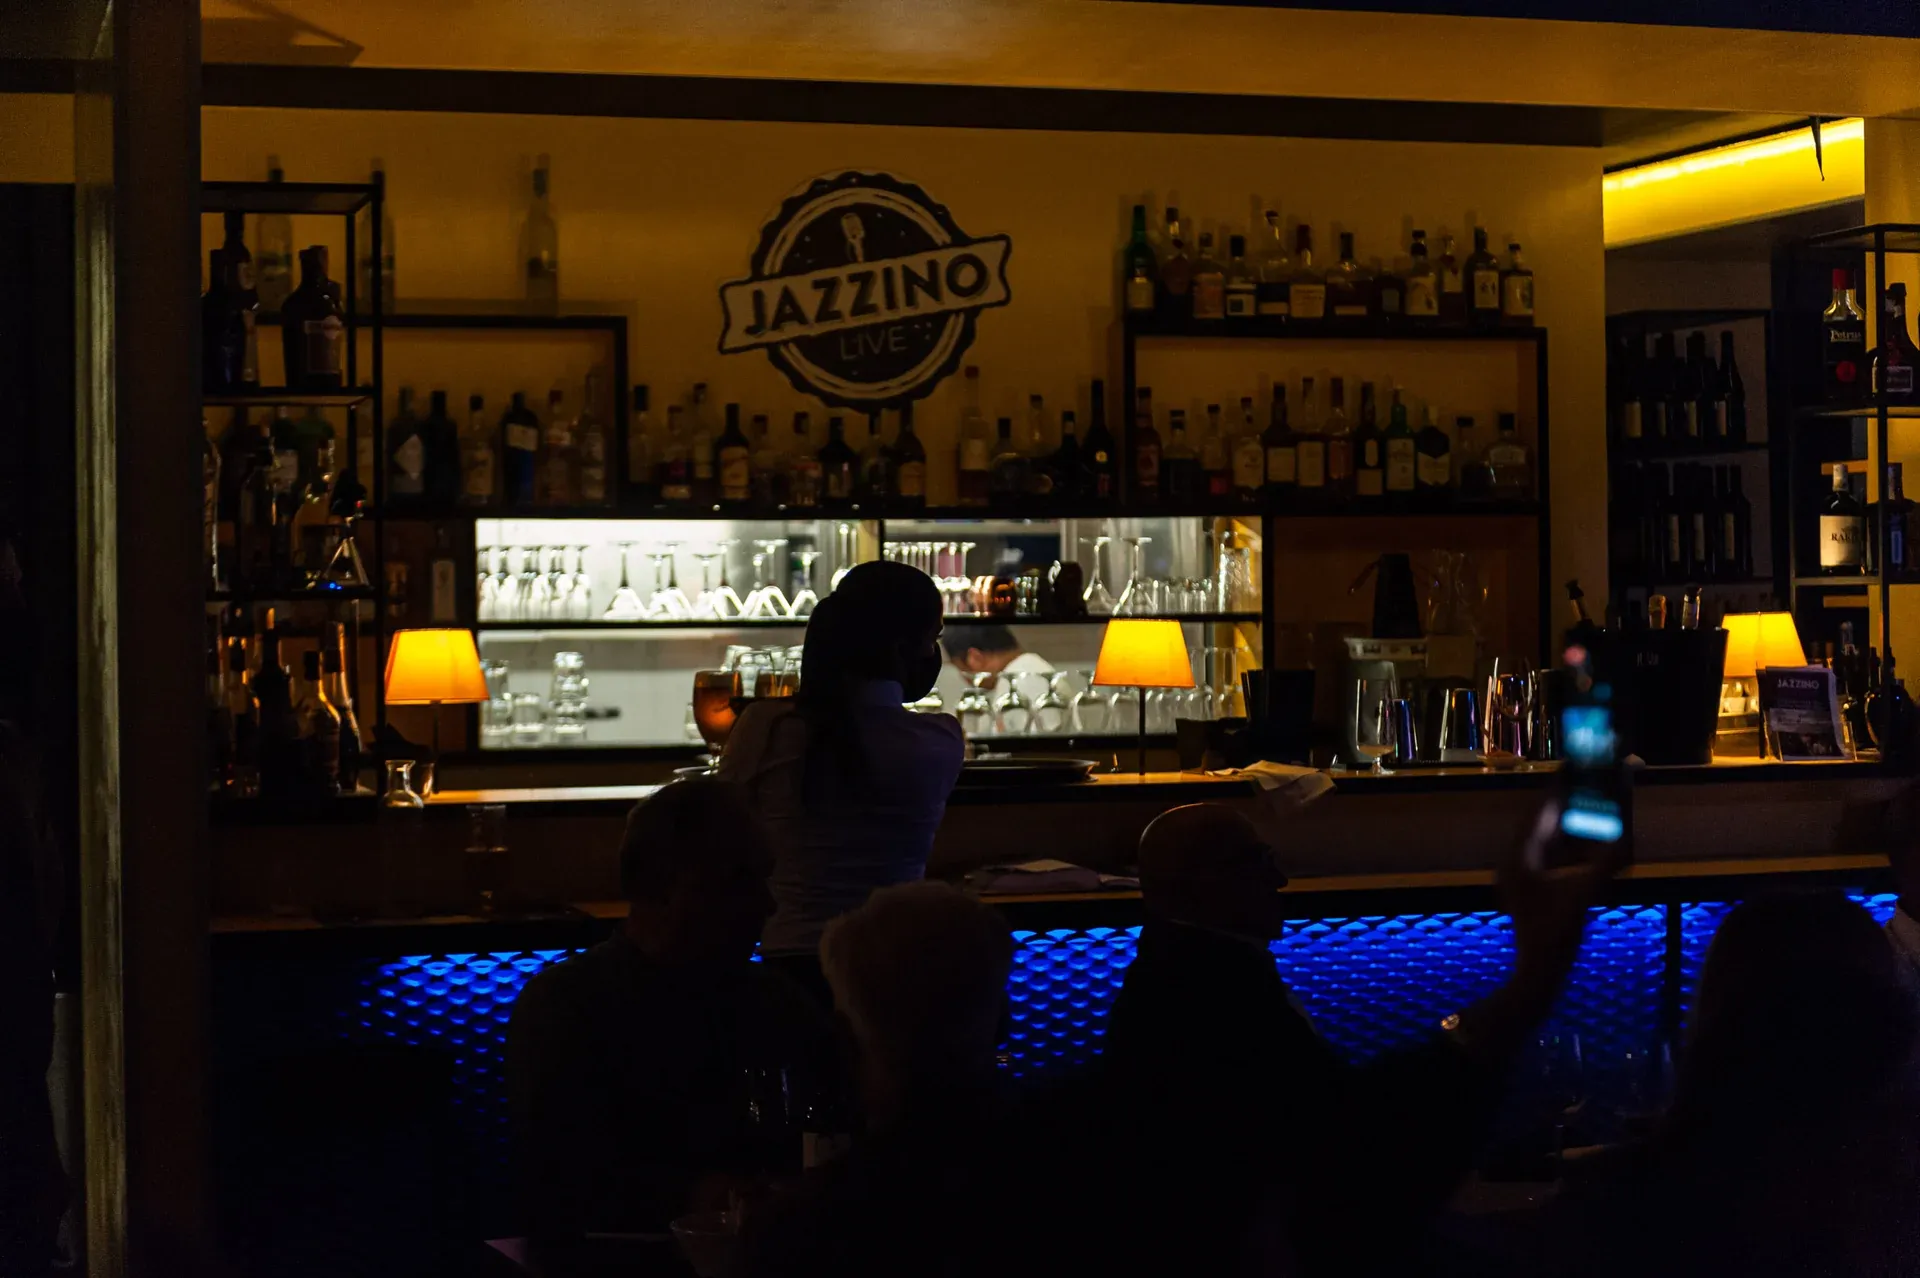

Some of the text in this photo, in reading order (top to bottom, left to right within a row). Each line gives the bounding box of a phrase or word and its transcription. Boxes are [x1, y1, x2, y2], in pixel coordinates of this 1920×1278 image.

[744, 253, 988, 335] JAZZINO
[839, 325, 908, 361] LIVE
[1777, 678, 1820, 690] JAZZINO
